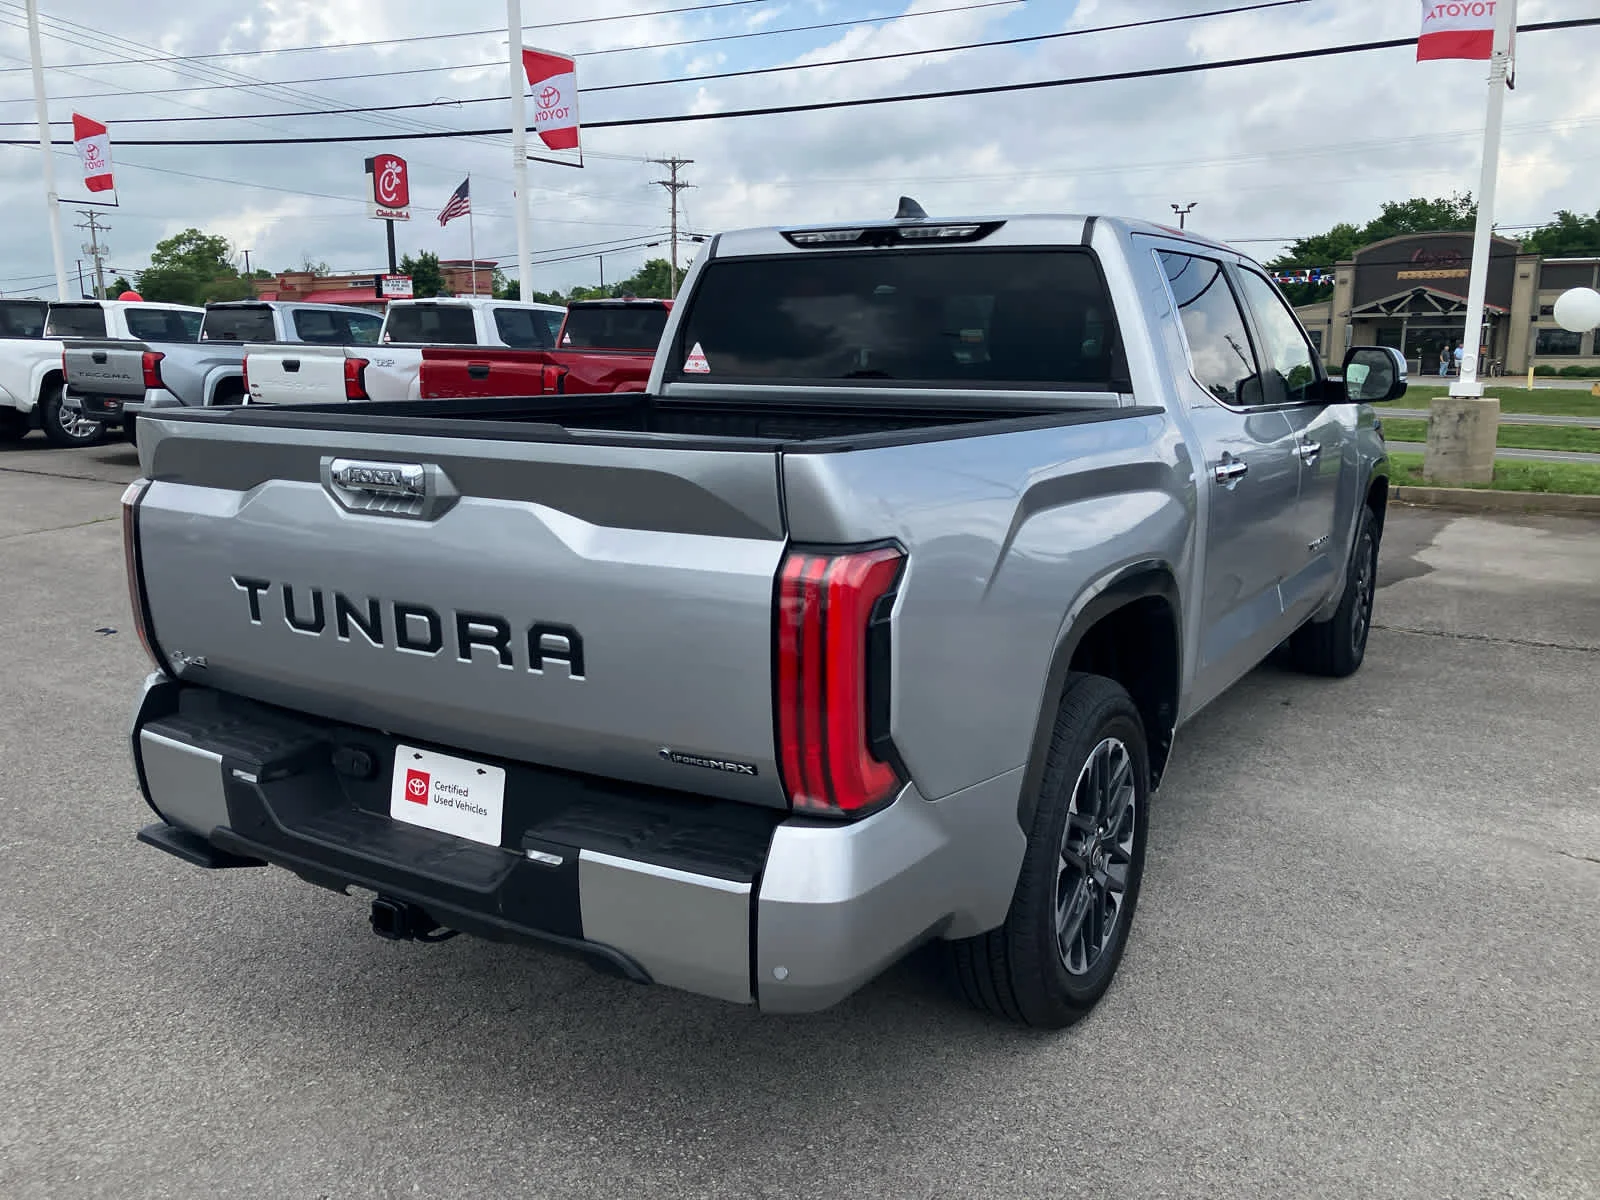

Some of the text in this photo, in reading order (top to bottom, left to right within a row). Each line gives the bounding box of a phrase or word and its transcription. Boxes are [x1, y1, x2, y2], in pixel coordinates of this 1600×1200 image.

[230, 574, 586, 681] TUNDRA
[434, 781, 469, 797] Certified
[433, 794, 488, 816] Used Vehicles
